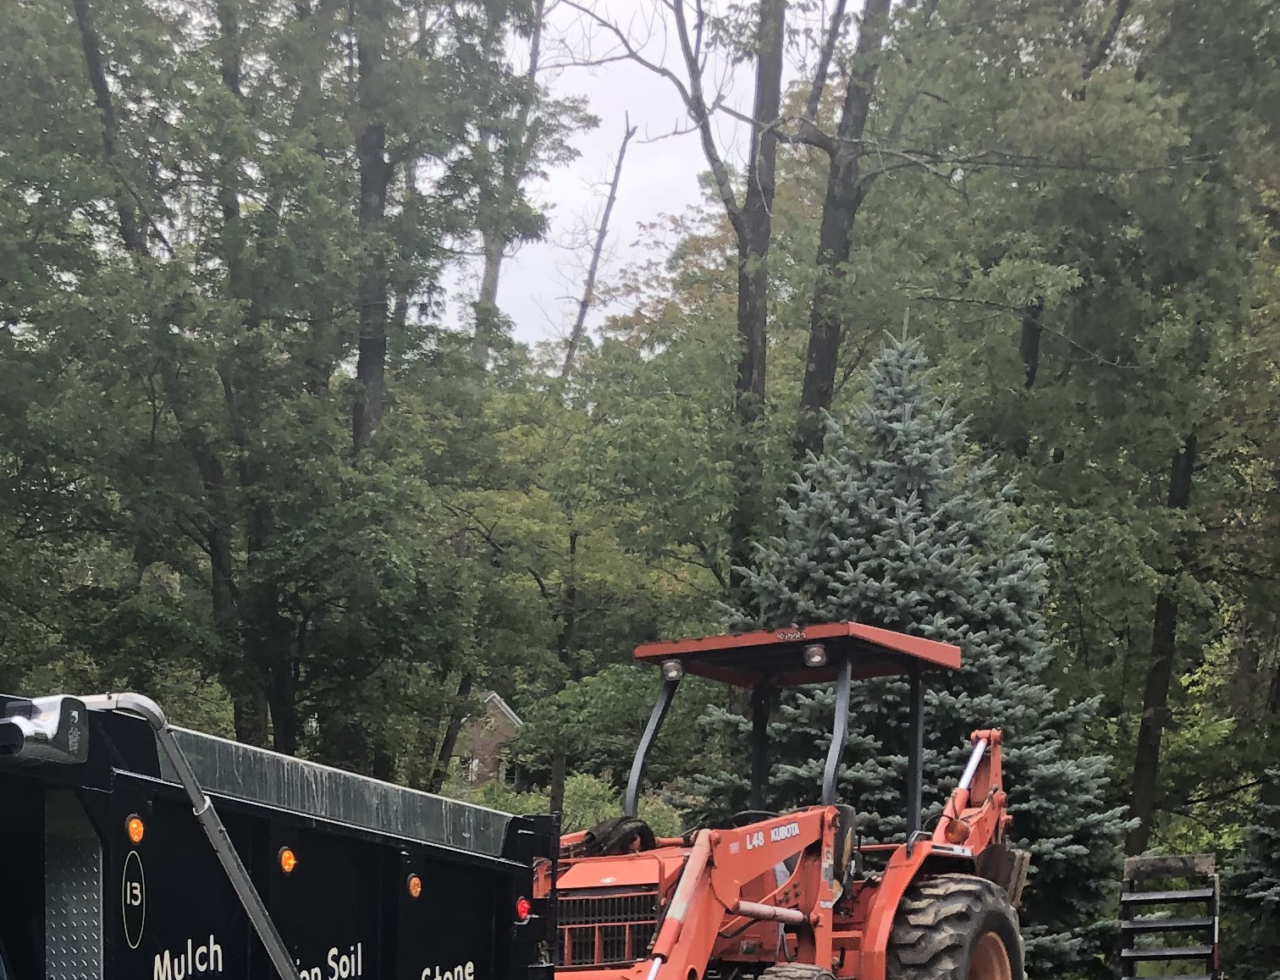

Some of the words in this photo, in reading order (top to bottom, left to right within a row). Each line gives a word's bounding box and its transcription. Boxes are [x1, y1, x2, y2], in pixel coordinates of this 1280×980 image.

[746, 831, 765, 850] L48
[770, 822, 801, 842] KUBOTA
[126, 881, 142, 906] 13
